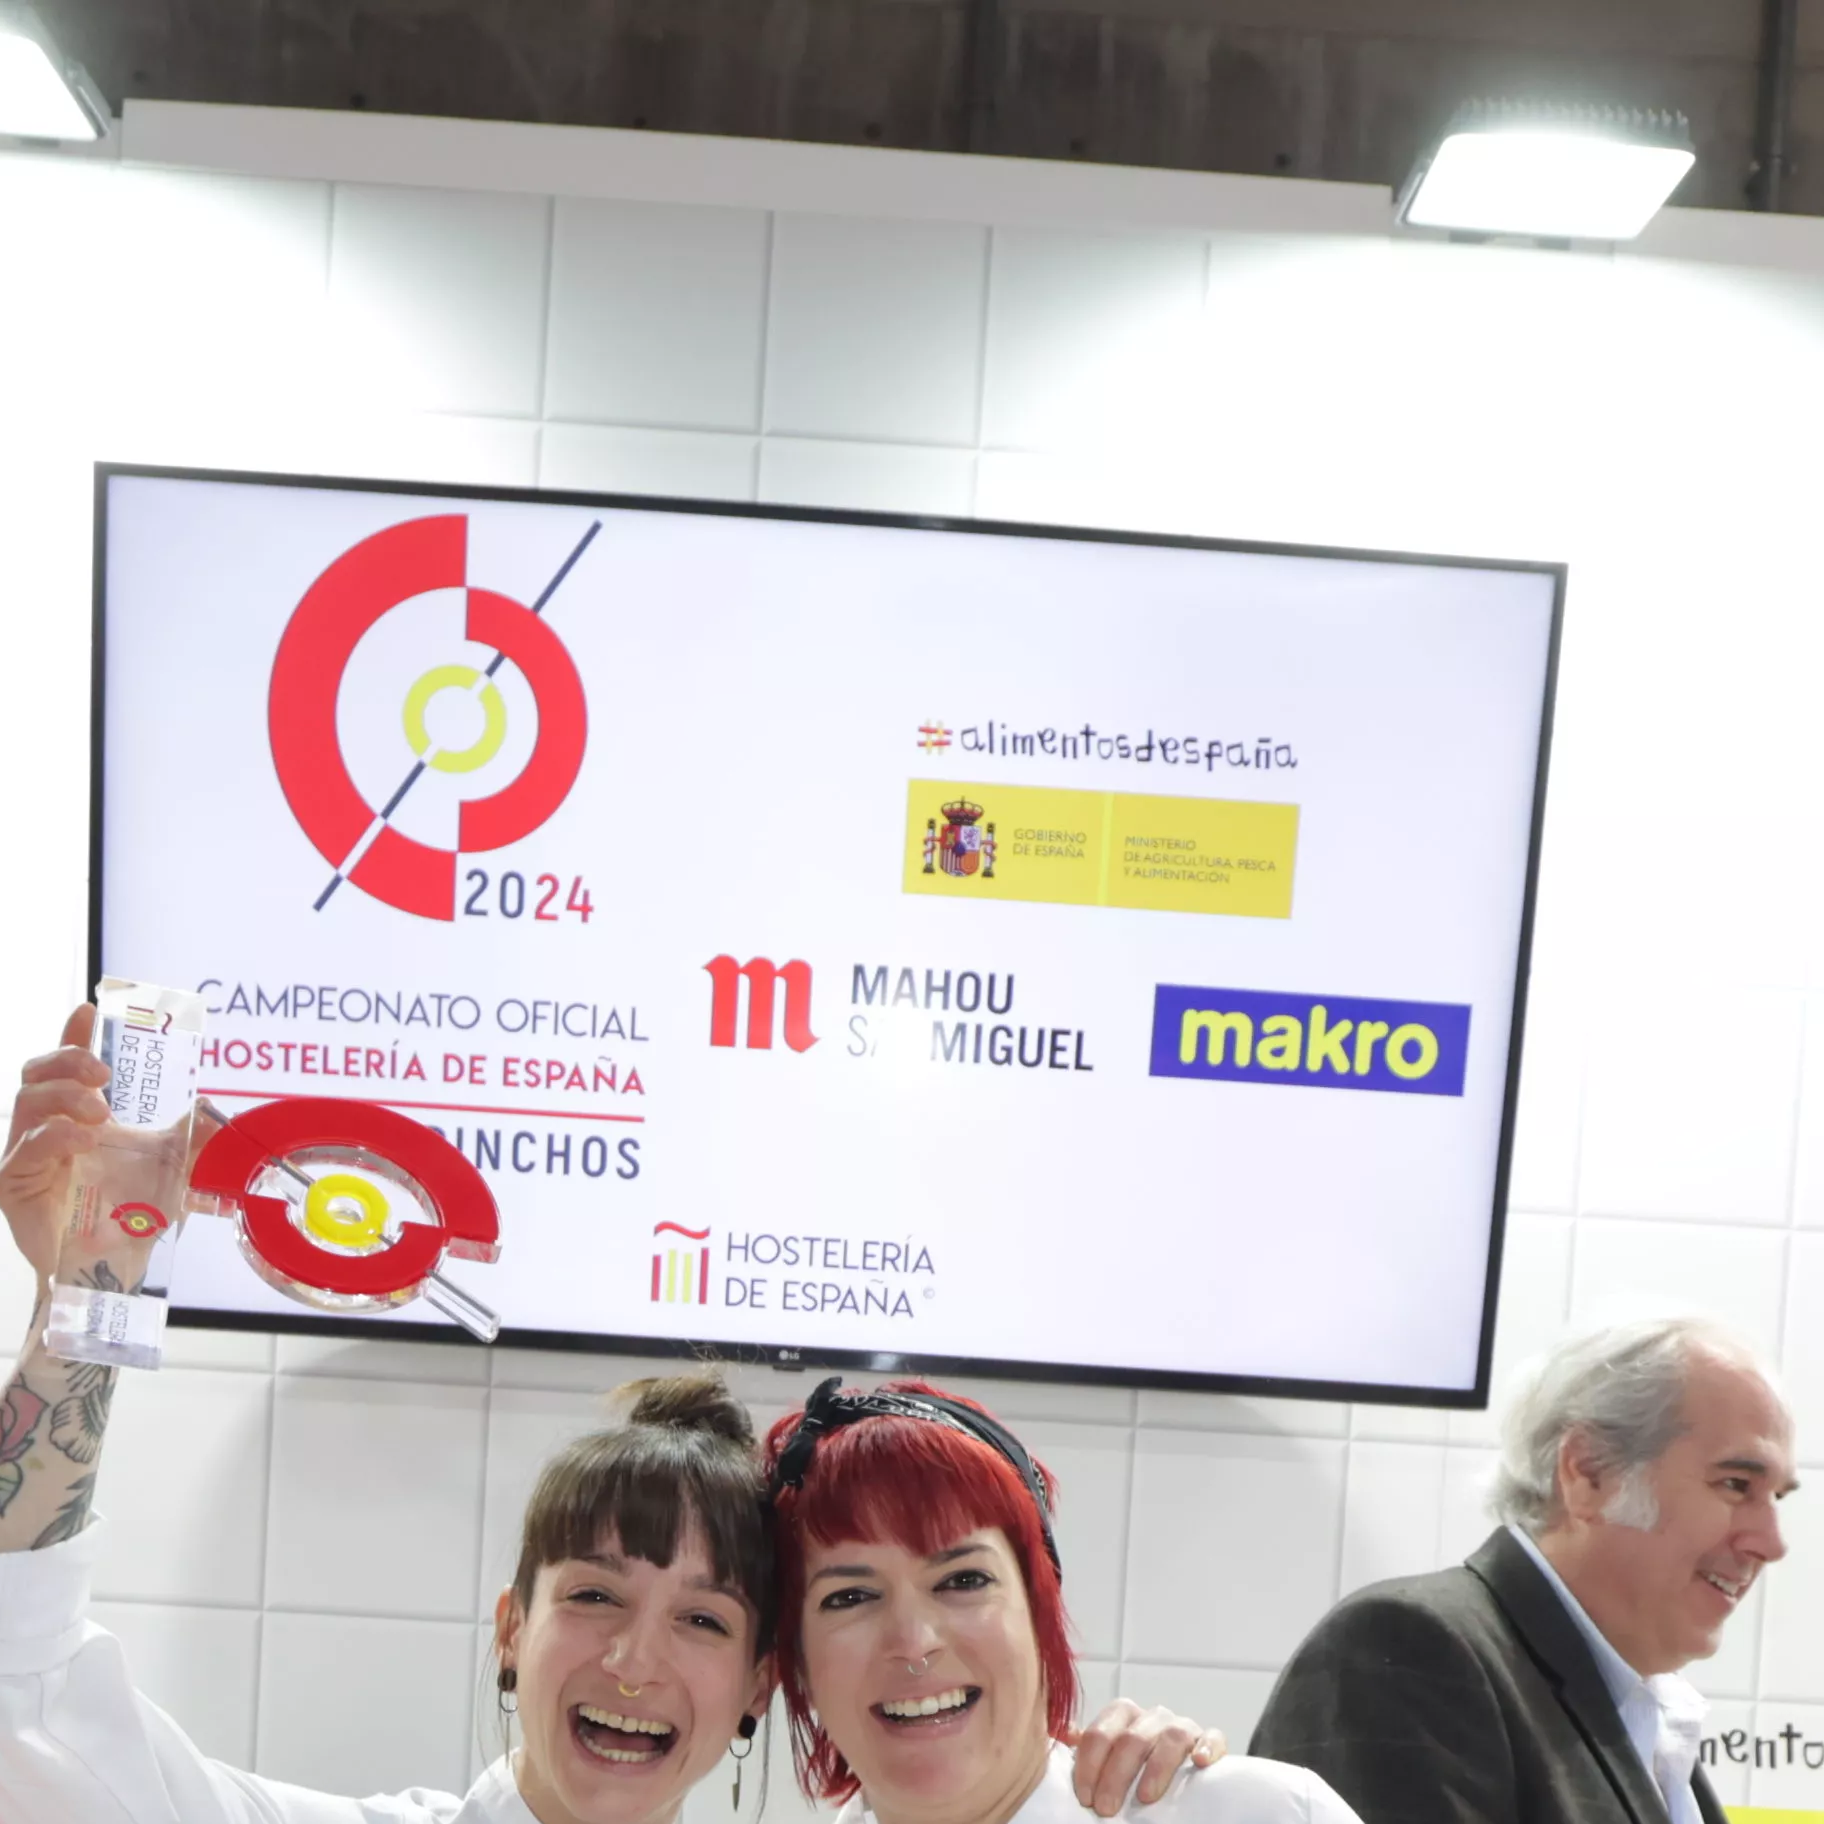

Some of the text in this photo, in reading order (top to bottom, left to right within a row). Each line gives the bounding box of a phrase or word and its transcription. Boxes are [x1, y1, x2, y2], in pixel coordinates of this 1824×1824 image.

[1013, 843, 1084, 858] DE ESPAÑA
[1014, 829, 1086, 844] GOBIERNO
[1125, 837, 1196, 850] MINISTERIO
[1124, 851, 1144, 862] DE
[1238, 859, 1276, 871] PESCA
[1133, 868, 1230, 883] ALIMENTACIÓN
[465, 869, 594, 923] 2024
[197, 979, 649, 1040] CAMPEONATO OFICIAL
[851, 964, 1014, 1014] MAHOU
[120, 1034, 140, 1054] DE
[847, 1014, 1093, 1071] SMIGUEL
[1181, 1006, 1437, 1080] makro
[199, 1039, 645, 1094] HOSTELERÍA DE ESPAÑA
[427, 1125, 640, 1179] INCHOS
[726, 1233, 935, 1276] HOSTELERÍA
[725, 1277, 914, 1318] DE ESPAÑA
